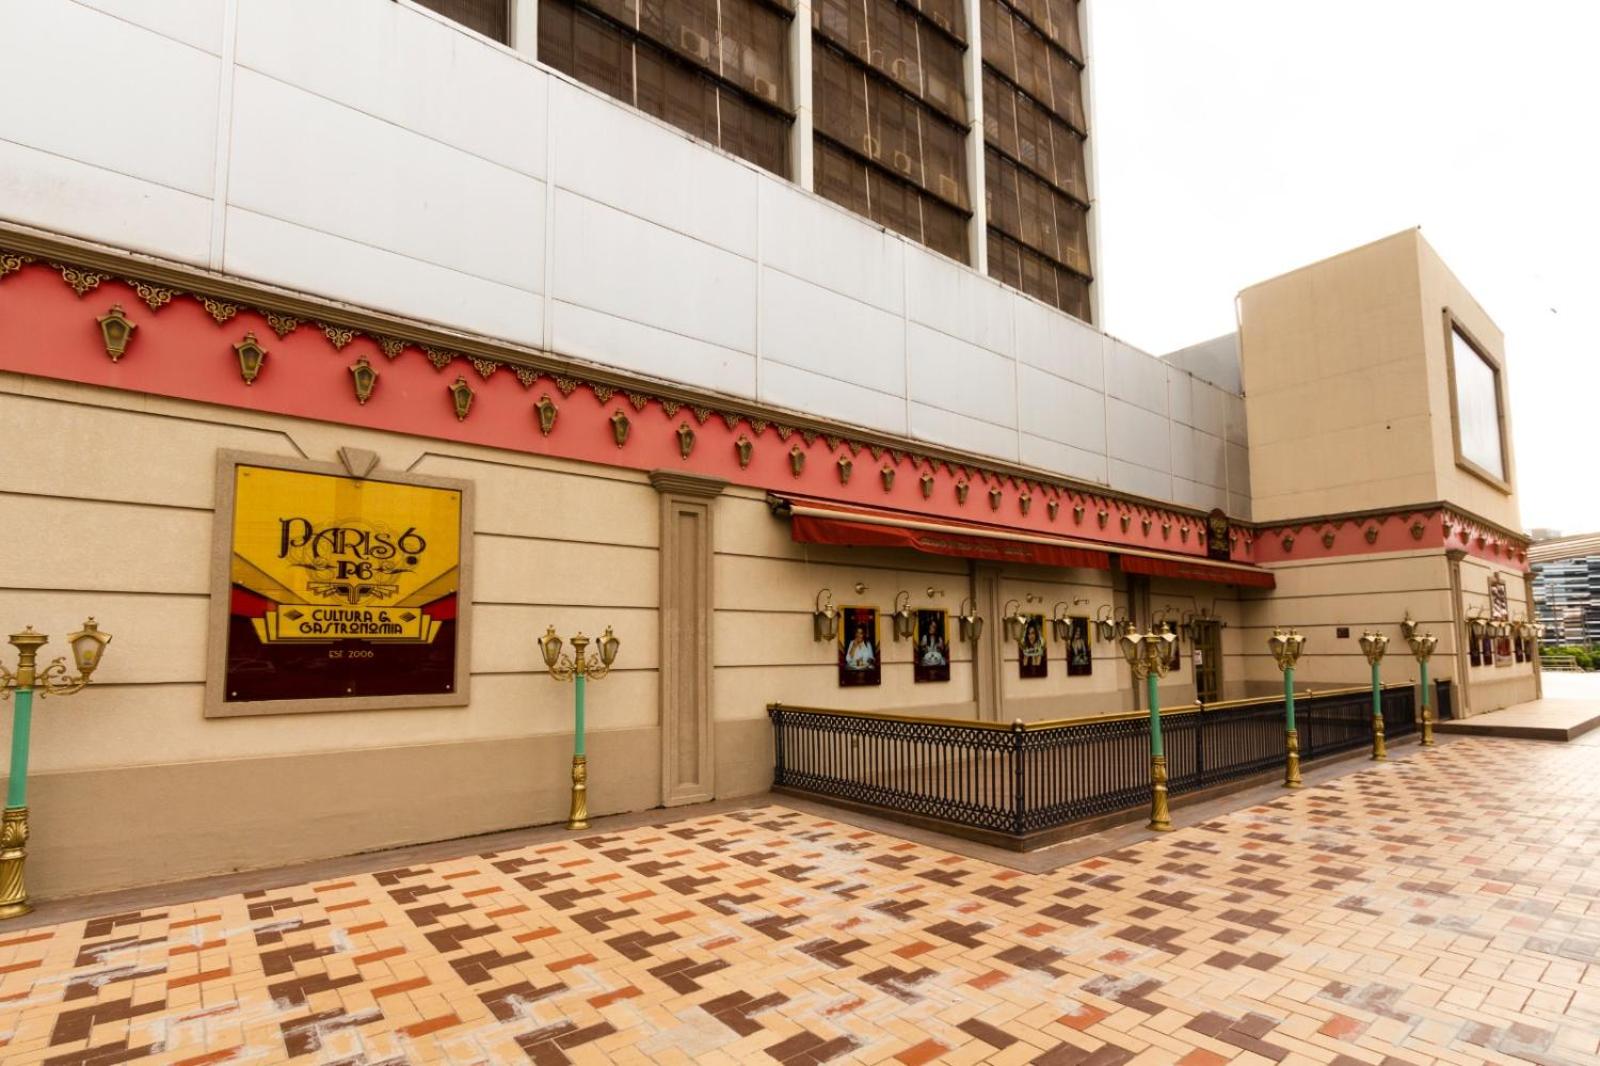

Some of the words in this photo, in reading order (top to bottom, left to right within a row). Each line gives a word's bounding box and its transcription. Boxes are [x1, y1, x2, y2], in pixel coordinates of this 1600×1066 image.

[278, 517, 396, 560] PARIS
[397, 527, 426, 555] 6
[312, 609, 373, 622] CULTURA
[378, 611, 391, 622] &
[299, 622, 403, 634] GASTRONOMIA
[347, 650, 374, 658] 2006
